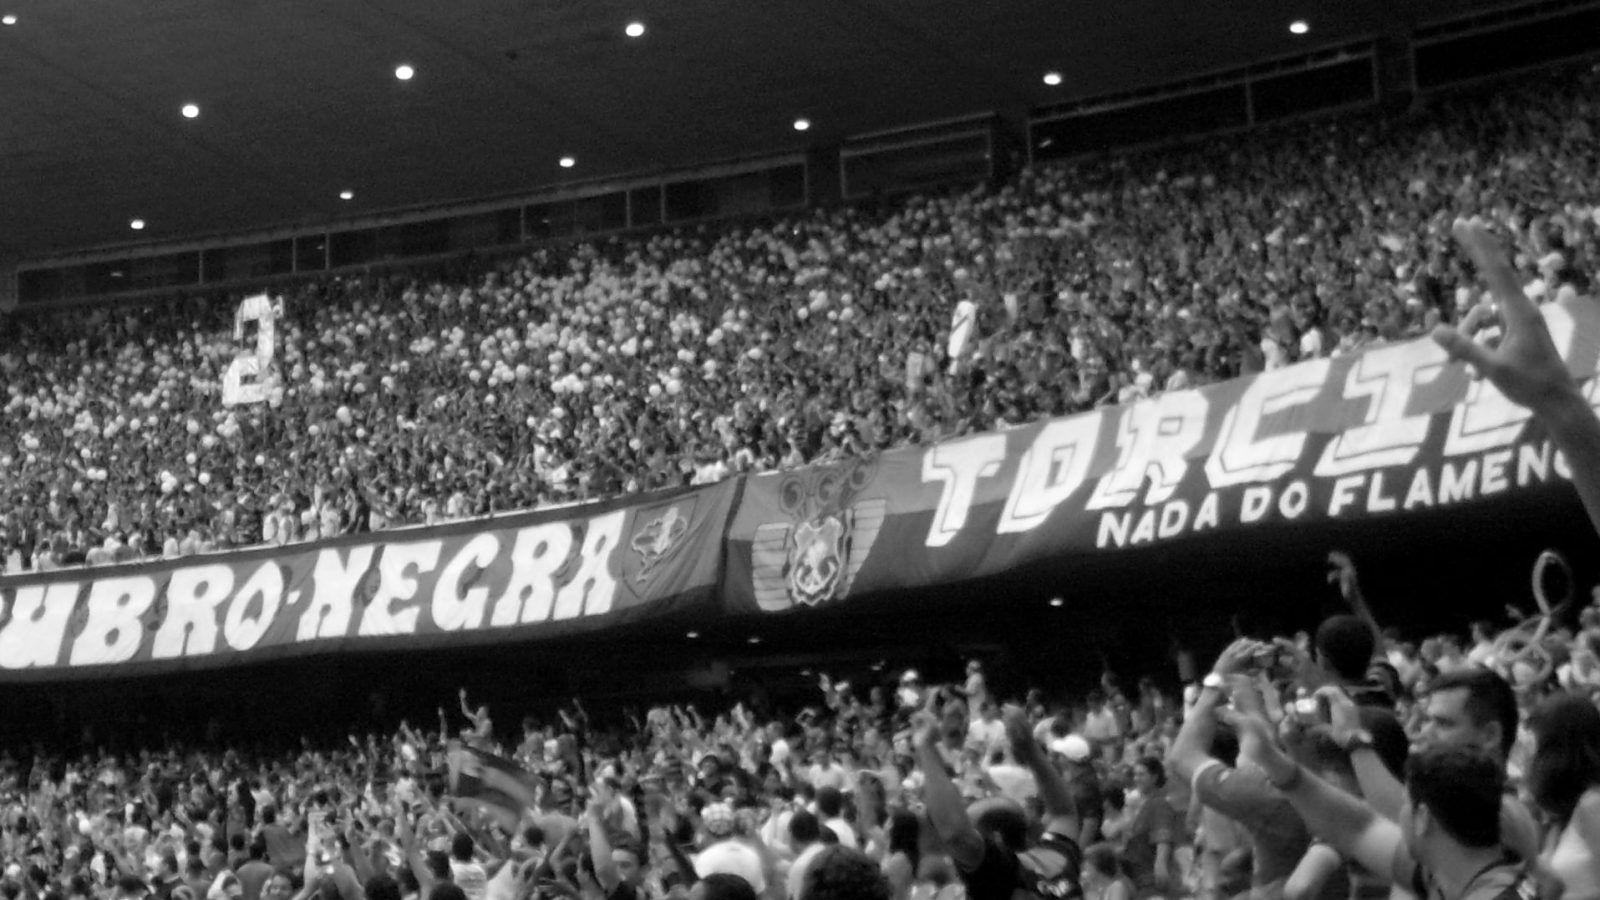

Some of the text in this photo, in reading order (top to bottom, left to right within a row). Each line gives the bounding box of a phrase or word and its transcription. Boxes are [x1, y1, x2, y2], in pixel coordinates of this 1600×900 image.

[921, 302, 1600, 547] TORCI
[0, 510, 626, 669] UBRO-NEGRA
[1096, 491, 1219, 548] NADA
[1240, 479, 1308, 523] DO
